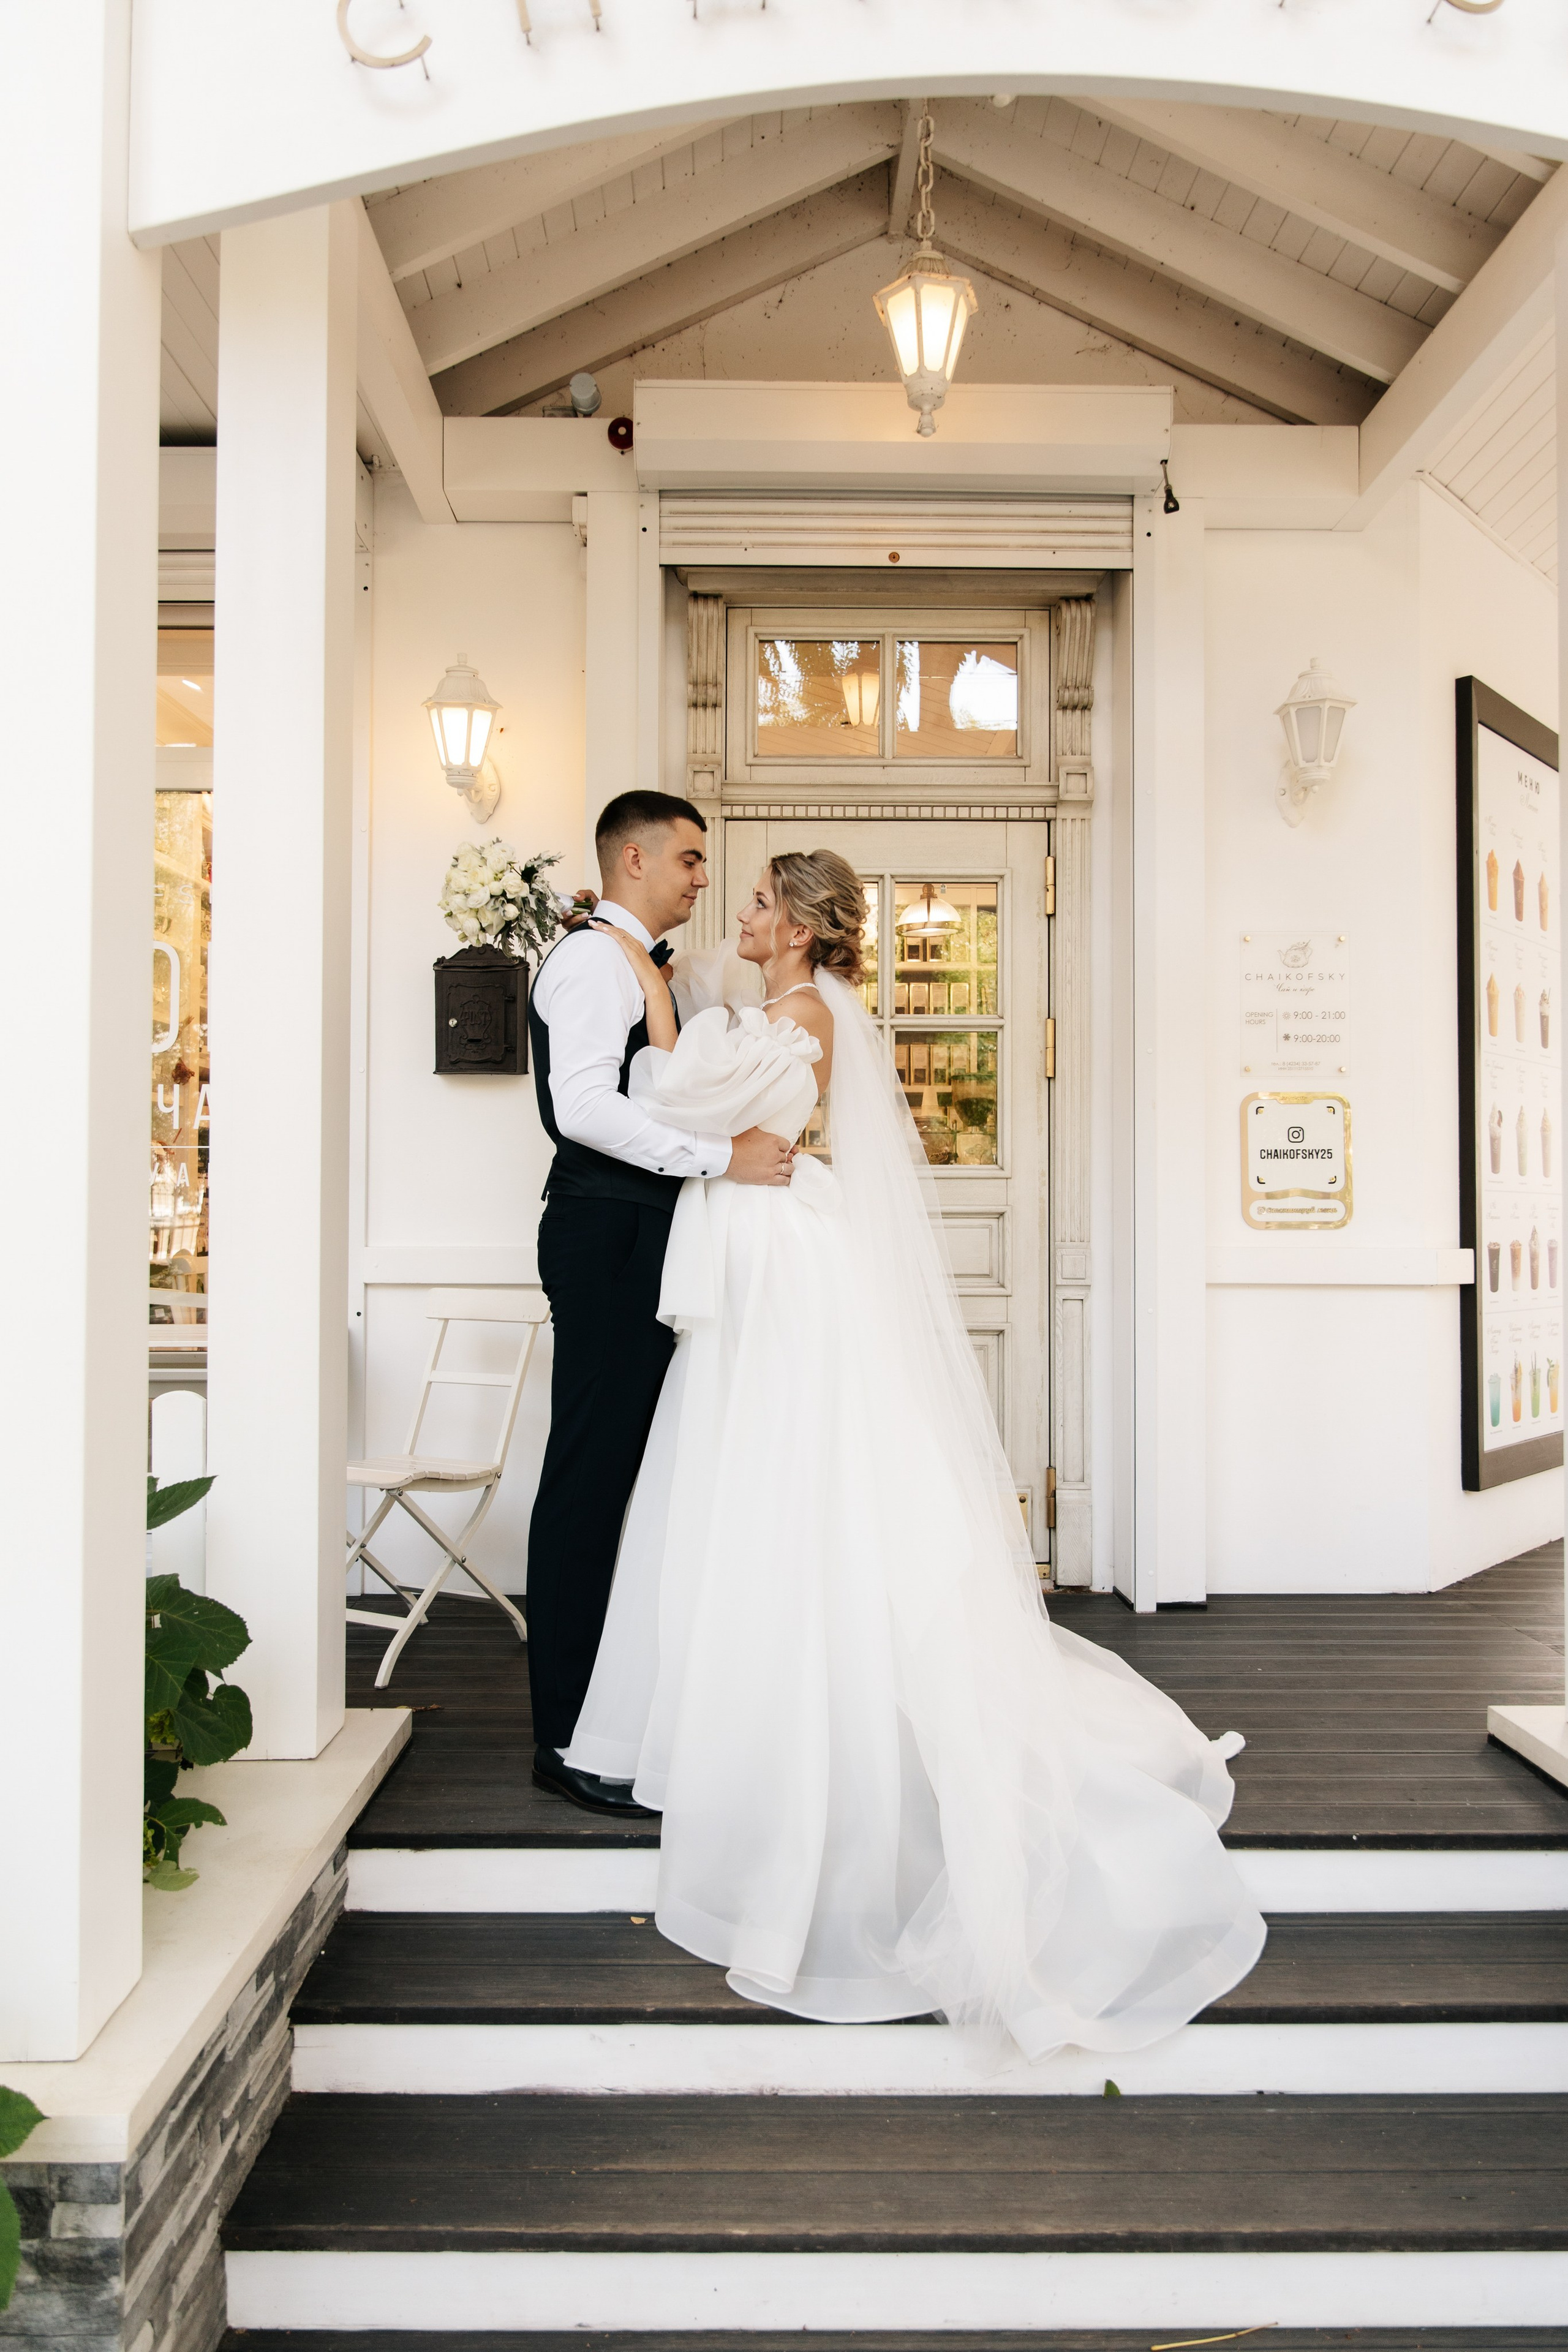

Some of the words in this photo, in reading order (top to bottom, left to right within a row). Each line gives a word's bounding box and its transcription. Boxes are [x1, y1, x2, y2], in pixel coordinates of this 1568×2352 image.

[1517, 771, 1540, 795] МЕНЮ
[1276, 982, 1291, 992] Чай
[1299, 987, 1315, 996] кофе
[1293, 1011, 1313, 1019] 9:00
[1321, 1011, 1346, 1019] 21:00
[1293, 1034, 1341, 1042] 9:00-20:00
[1260, 1148, 1333, 1159] CHAIKOFSKY25
